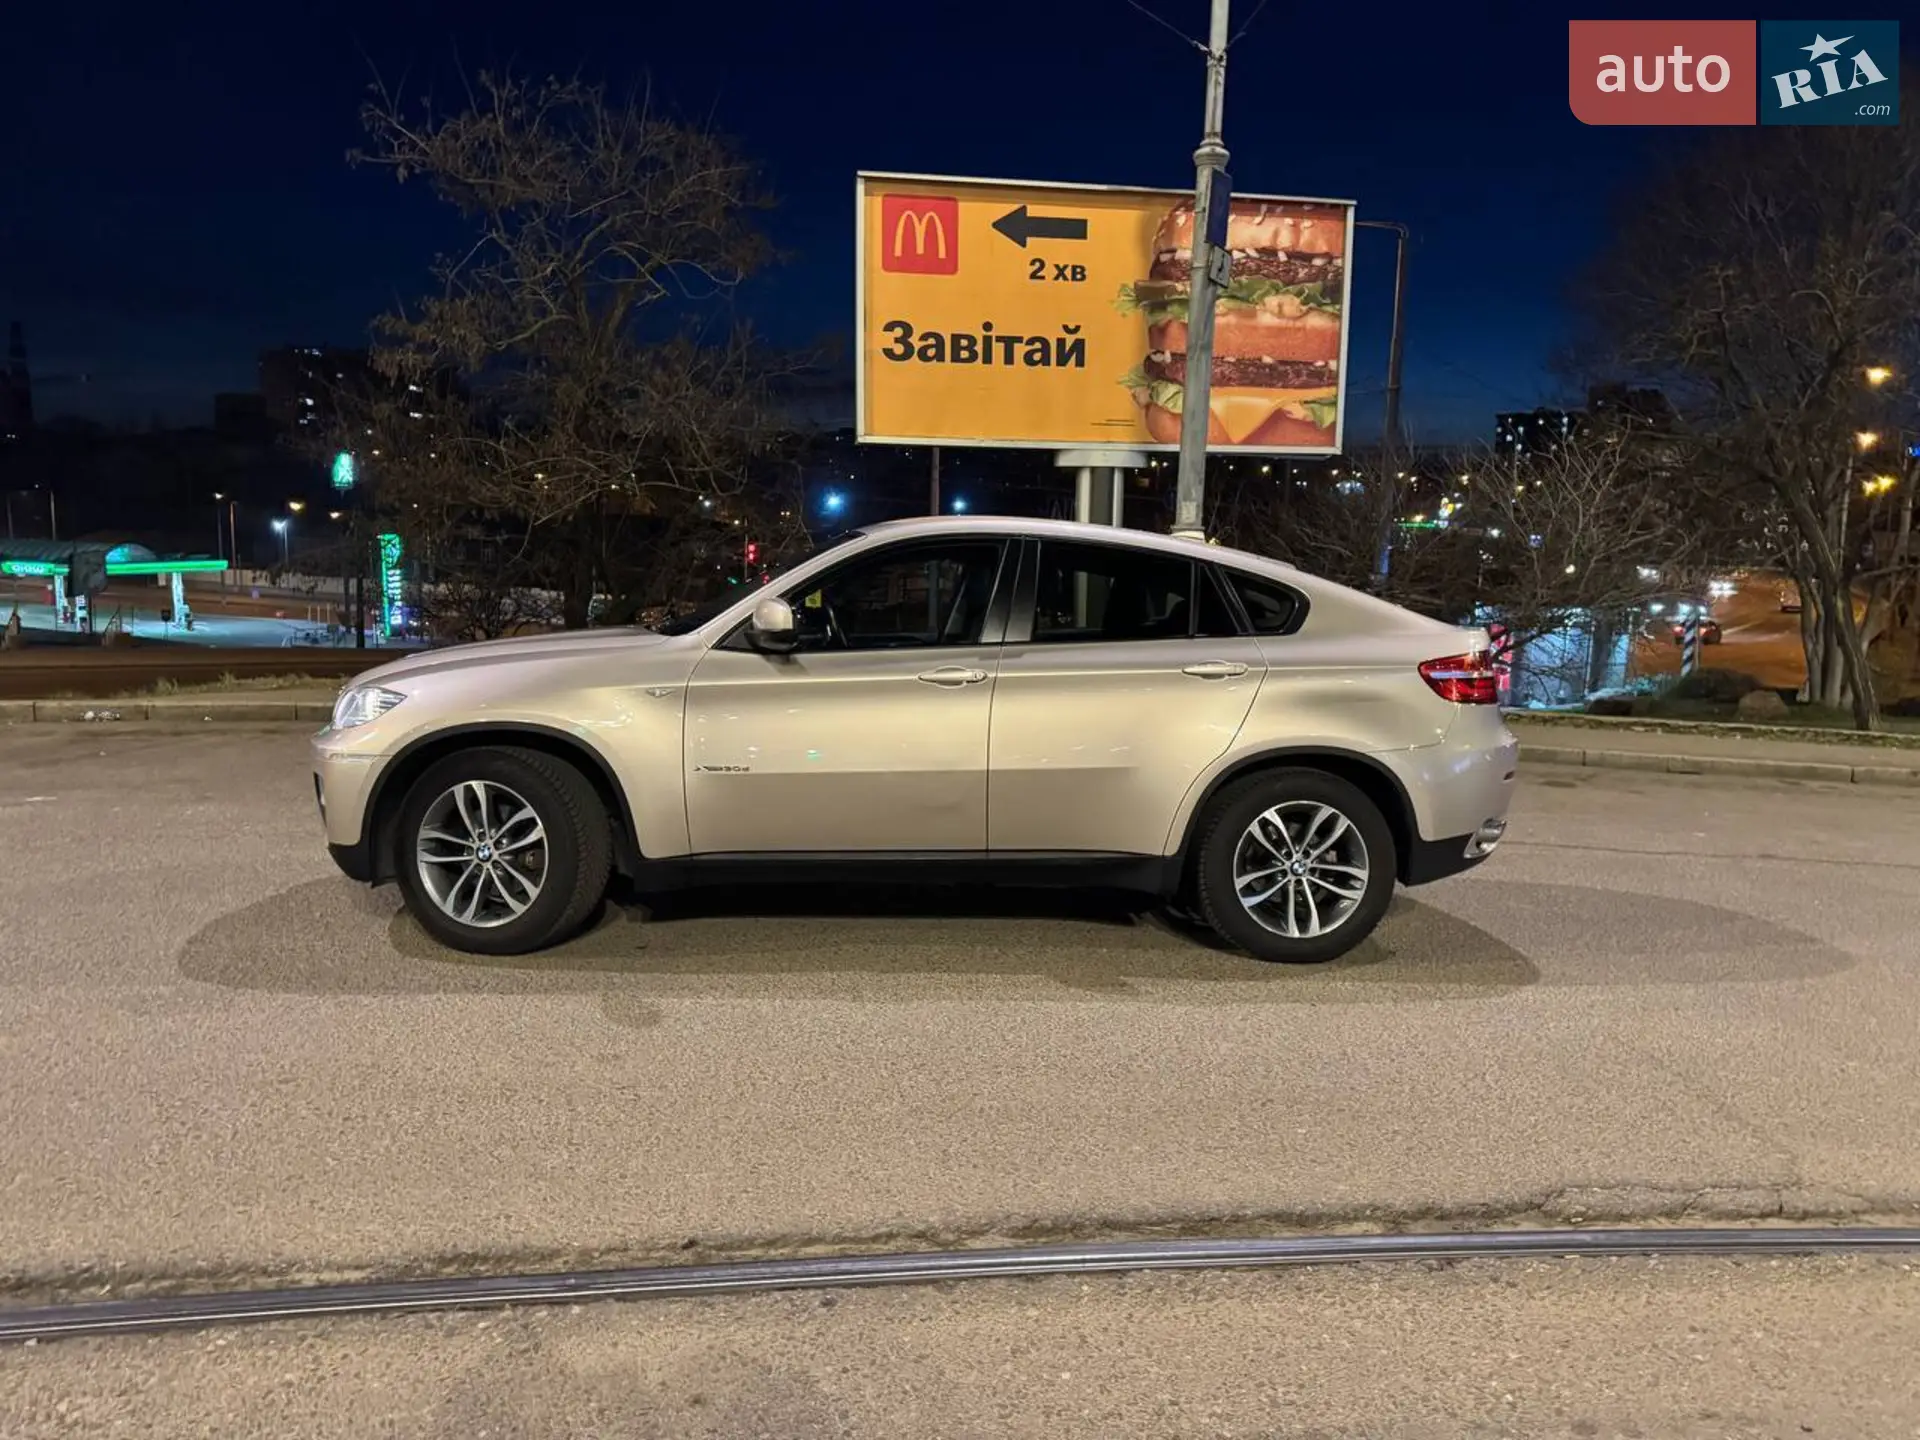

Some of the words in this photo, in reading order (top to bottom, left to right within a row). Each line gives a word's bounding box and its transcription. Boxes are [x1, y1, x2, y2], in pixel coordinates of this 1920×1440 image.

[1029, 258, 1046, 280] 2
[1053, 263, 1087, 282] хв
[882, 320, 1086, 368] Завітай
